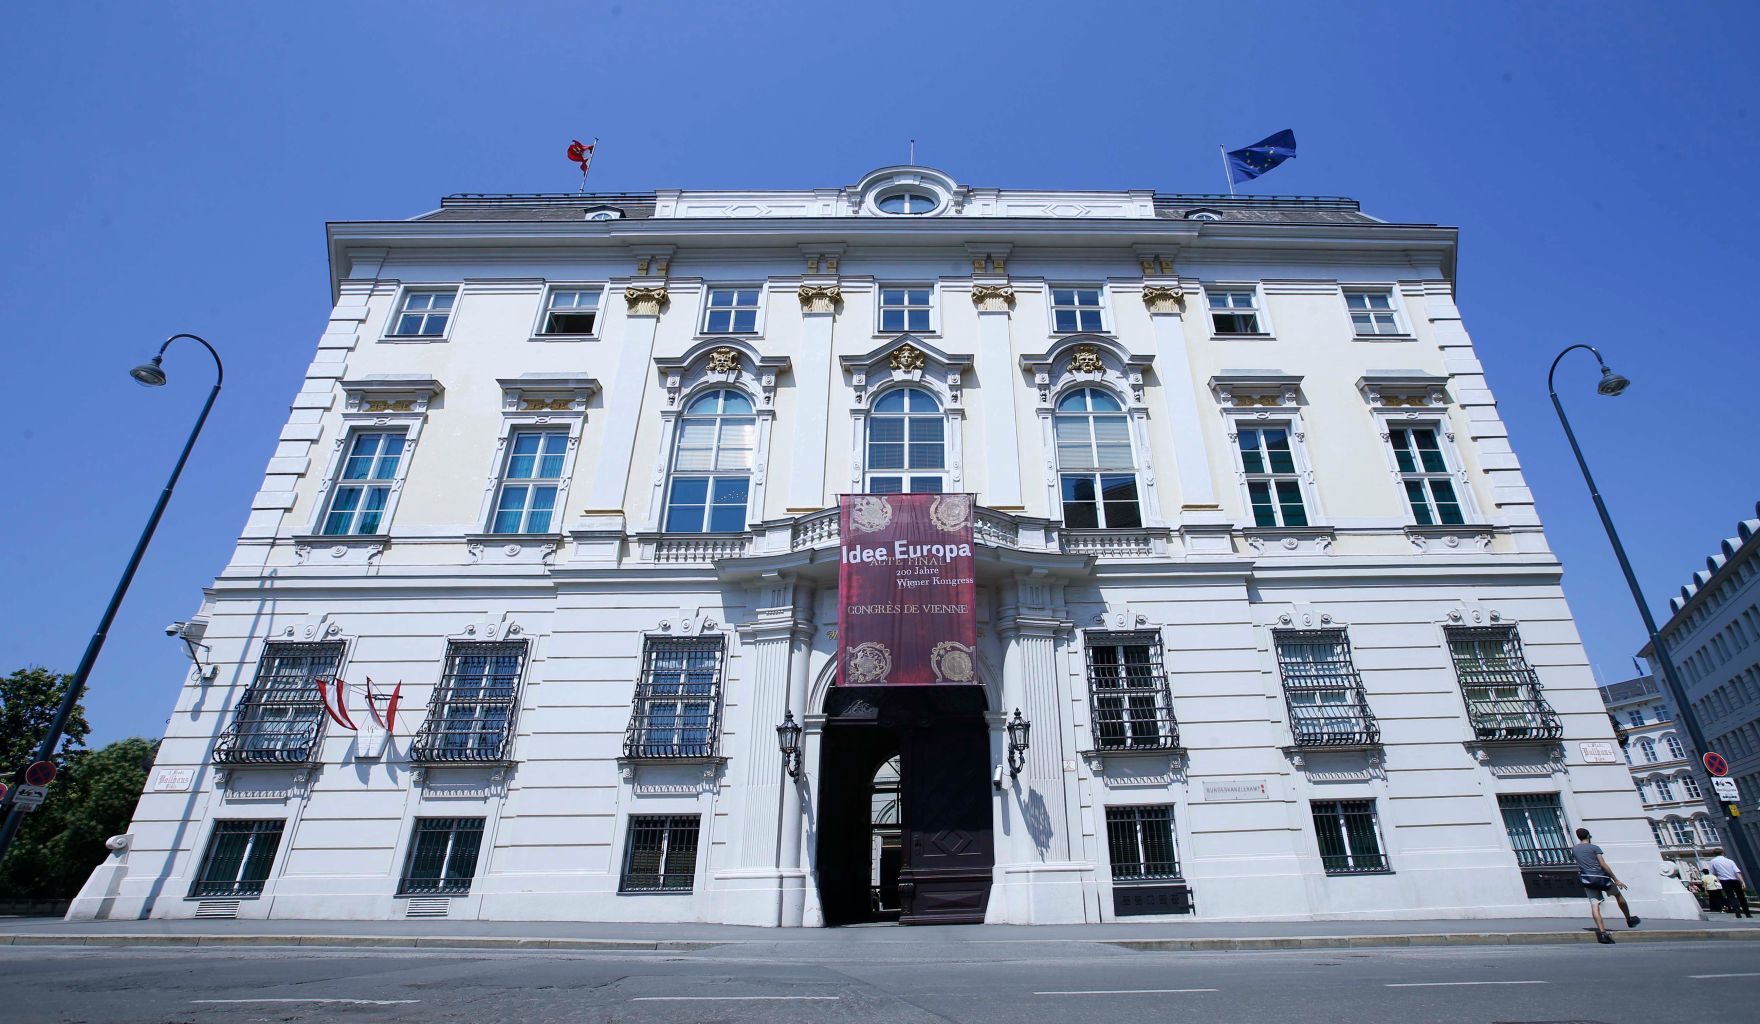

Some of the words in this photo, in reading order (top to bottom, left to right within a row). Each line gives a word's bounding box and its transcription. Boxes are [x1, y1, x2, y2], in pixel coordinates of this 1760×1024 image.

[842, 545, 887, 564] Idee
[894, 540, 972, 563] Europa
[907, 556, 946, 566] FINAL
[896, 568, 912, 576] 200
[914, 567, 939, 575] Jahre
[896, 578, 929, 587] Wiener
[932, 576, 974, 587] Kongress
[847, 601, 901, 615] CONGRÈS
[903, 604, 920, 614] DE
[922, 604, 968, 614] VIENNE
